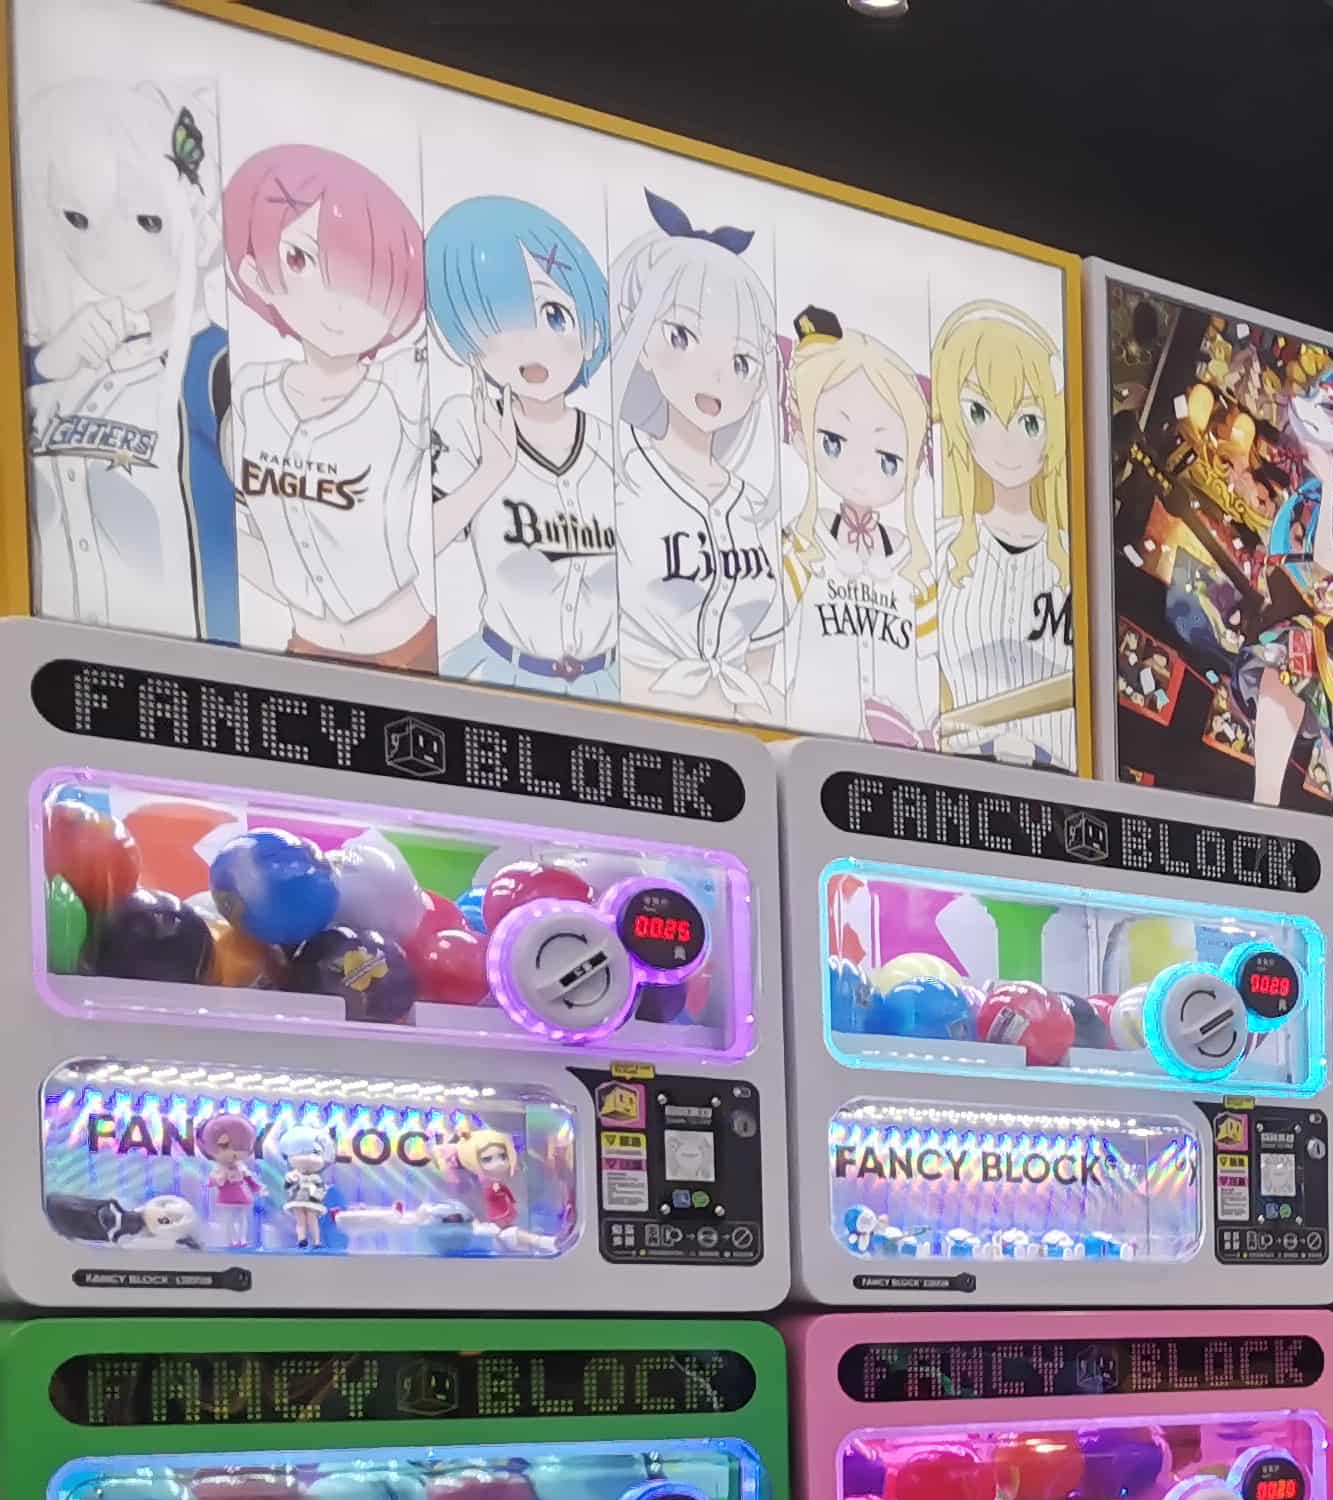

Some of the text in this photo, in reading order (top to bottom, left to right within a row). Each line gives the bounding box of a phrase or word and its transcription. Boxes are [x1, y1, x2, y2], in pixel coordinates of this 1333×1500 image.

[242, 458, 370, 510] EAGLES
[259, 451, 338, 475] RAKUTEN
[826, 578, 899, 610] SoftBank
[815, 603, 913, 650] HAWKS
[74, 667, 713, 819] FANCY BLOCK
[848, 777, 1297, 888] FANCY BLOCK
[834, 1145, 1102, 1186] FANCY BLOCK
[87, 1356, 725, 1422] FANCY BLOCK
[864, 1340, 1303, 1399] FANCY BLOCK
